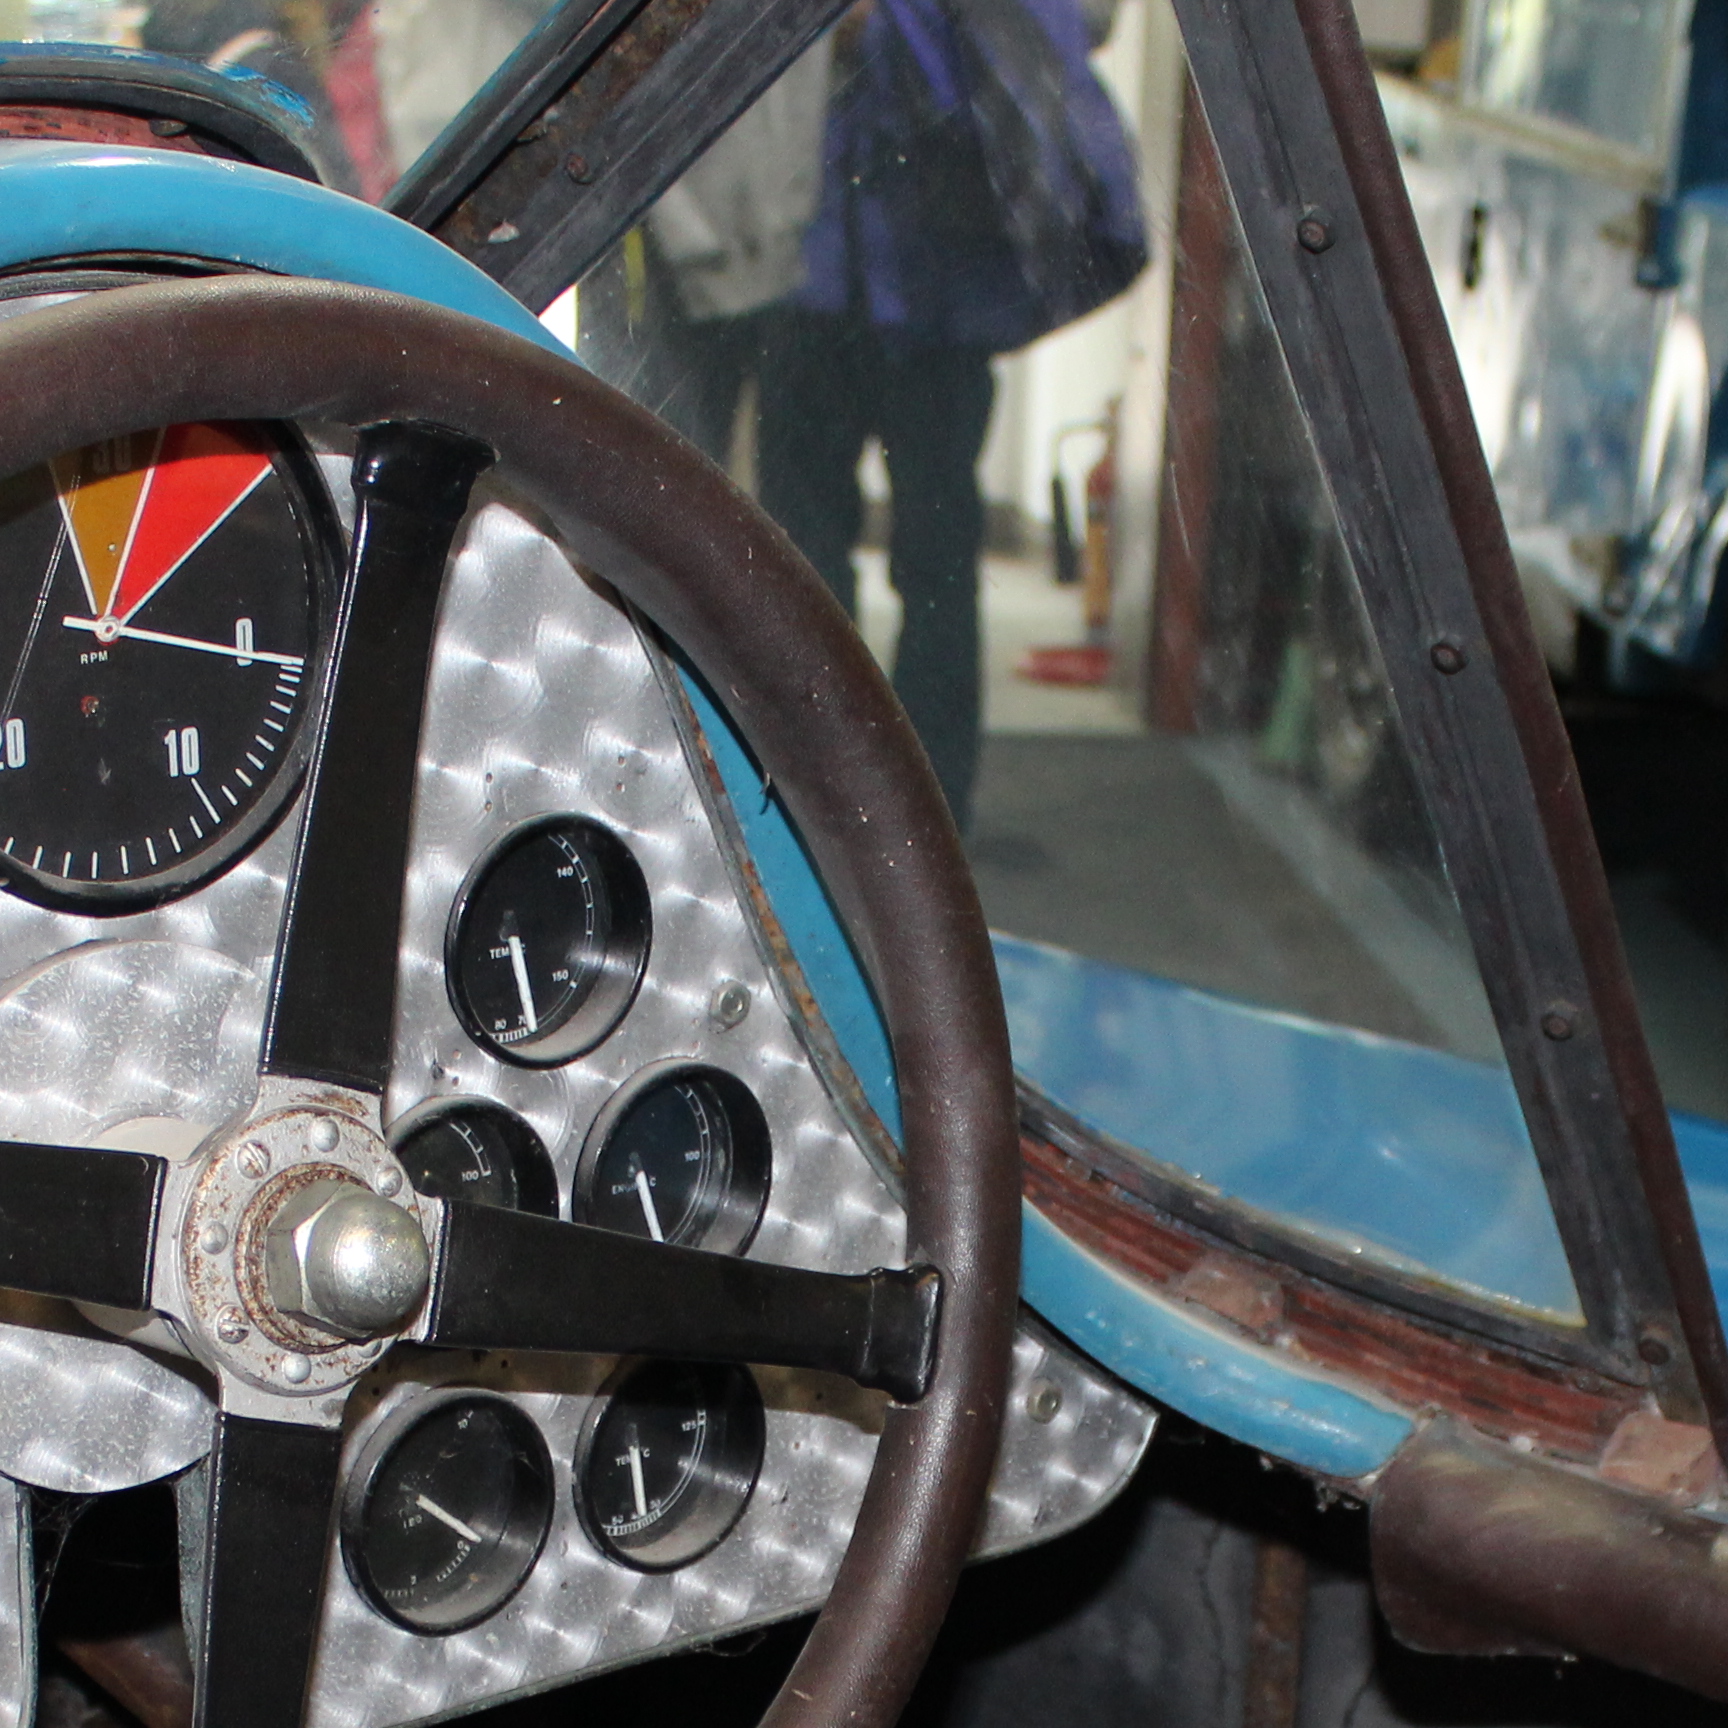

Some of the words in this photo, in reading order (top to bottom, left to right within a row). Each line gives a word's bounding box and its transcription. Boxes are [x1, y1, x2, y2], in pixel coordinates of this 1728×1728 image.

[235, 617, 254, 666] 0
[80, 650, 109, 665] RPM
[164, 726, 200, 777] 10
[557, 866, 574, 878] 140
[489, 947, 510, 960] TEM
[552, 969, 570, 982] 150
[685, 1150, 701, 1162] 100
[461, 1169, 480, 1182] 100
